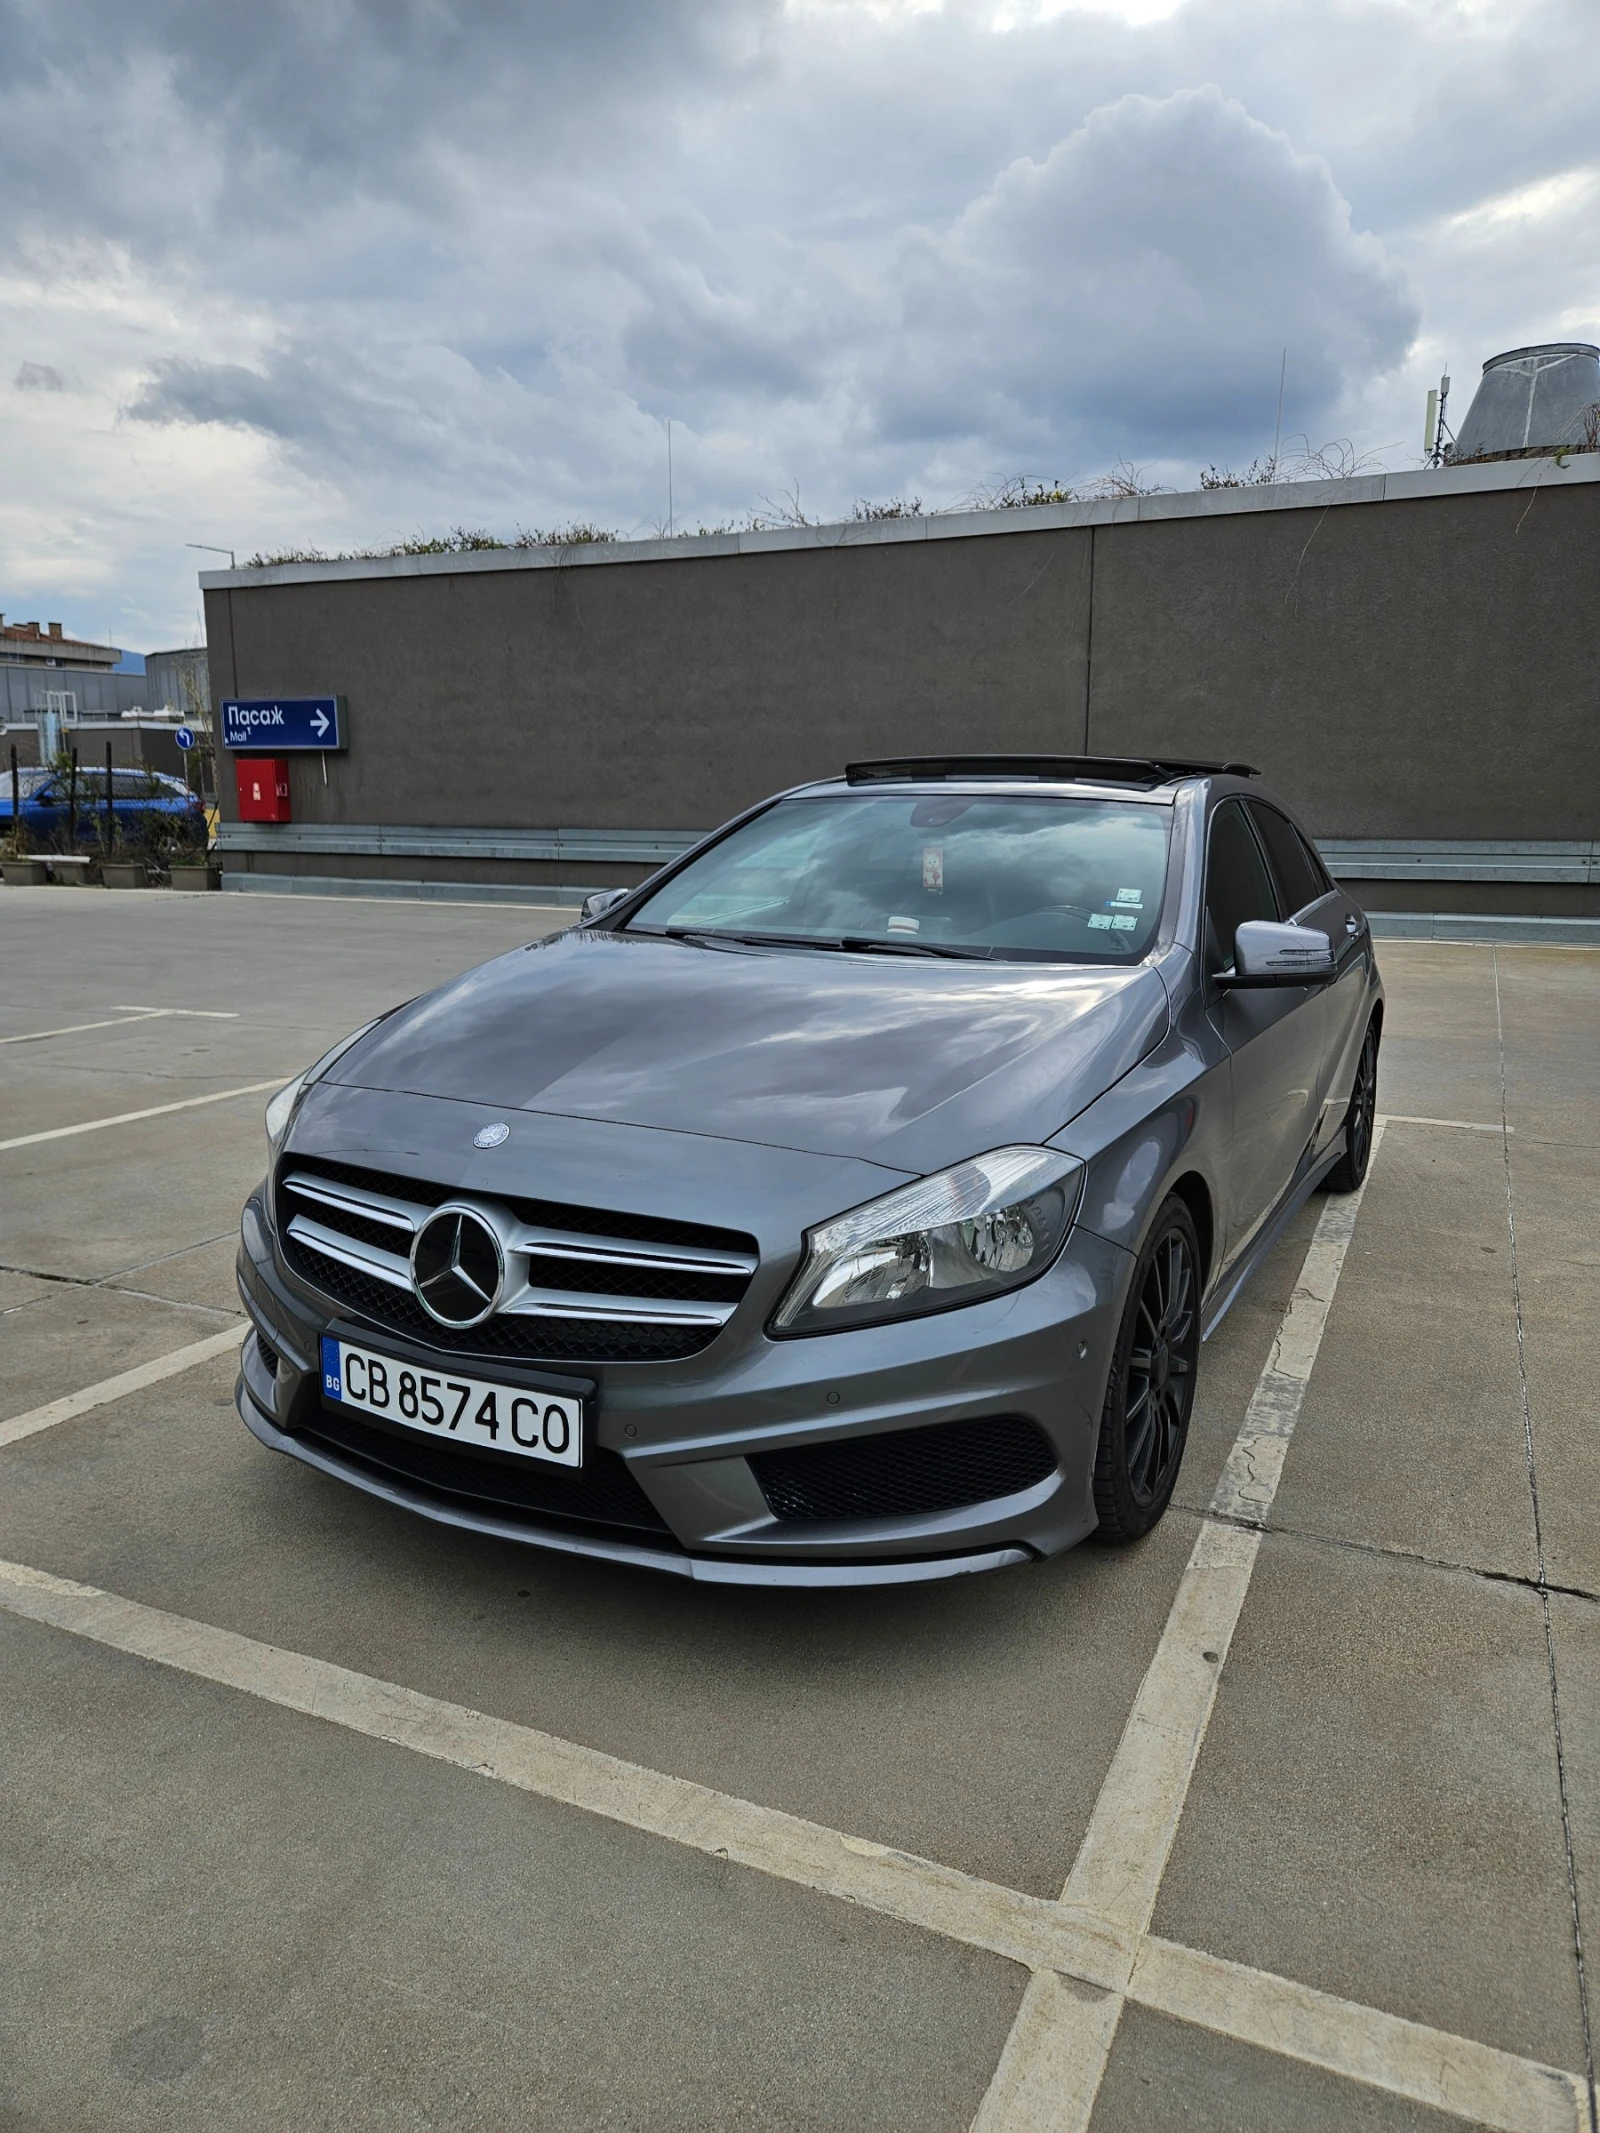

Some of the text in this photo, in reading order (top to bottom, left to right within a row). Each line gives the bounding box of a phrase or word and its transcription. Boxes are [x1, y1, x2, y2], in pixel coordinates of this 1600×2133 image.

[227, 705, 285, 725] Пасаж
[230, 731, 247, 742] Mall
[325, 1374, 340, 1392] BG
[345, 1353, 569, 1454] CB 8574 CO
